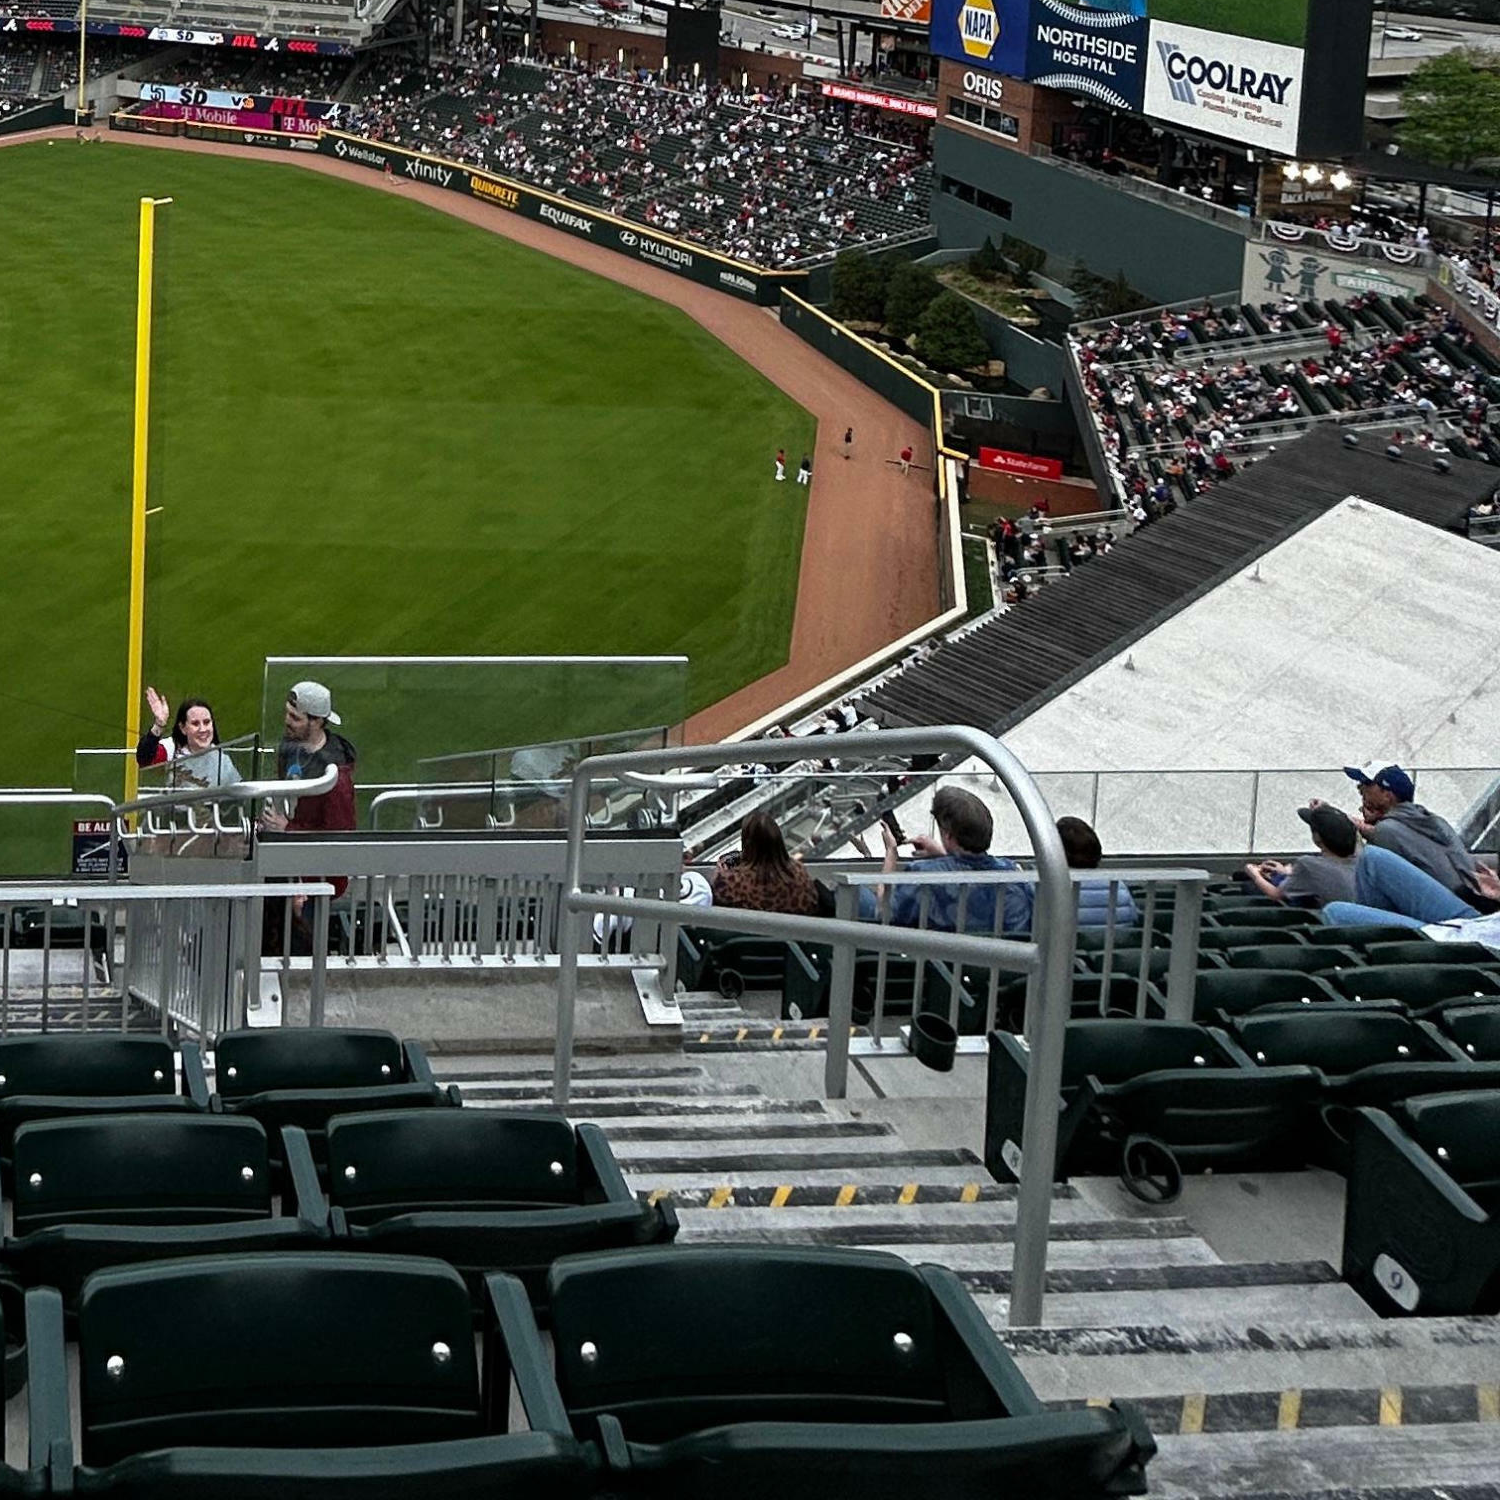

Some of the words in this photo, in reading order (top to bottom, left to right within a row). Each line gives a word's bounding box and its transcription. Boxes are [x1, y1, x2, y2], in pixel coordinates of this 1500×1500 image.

[964, 9, 993, 41] NAPA
[1037, 24, 1137, 64] NORTHSIDE
[1053, 49, 1116, 76] HOSPITAL
[963, 71, 1003, 100] ORIS
[1167, 52, 1293, 105] COOLRAY
[180, 88, 208, 104] SD
[195, 109, 237, 125] Mobile
[405, 159, 452, 186] xfinity
[470, 176, 519, 204] QUIKRETE
[540, 204, 592, 233] EQUIFAX
[640, 239, 693, 267] HYUNDAI
[77, 822, 92, 832] BE
